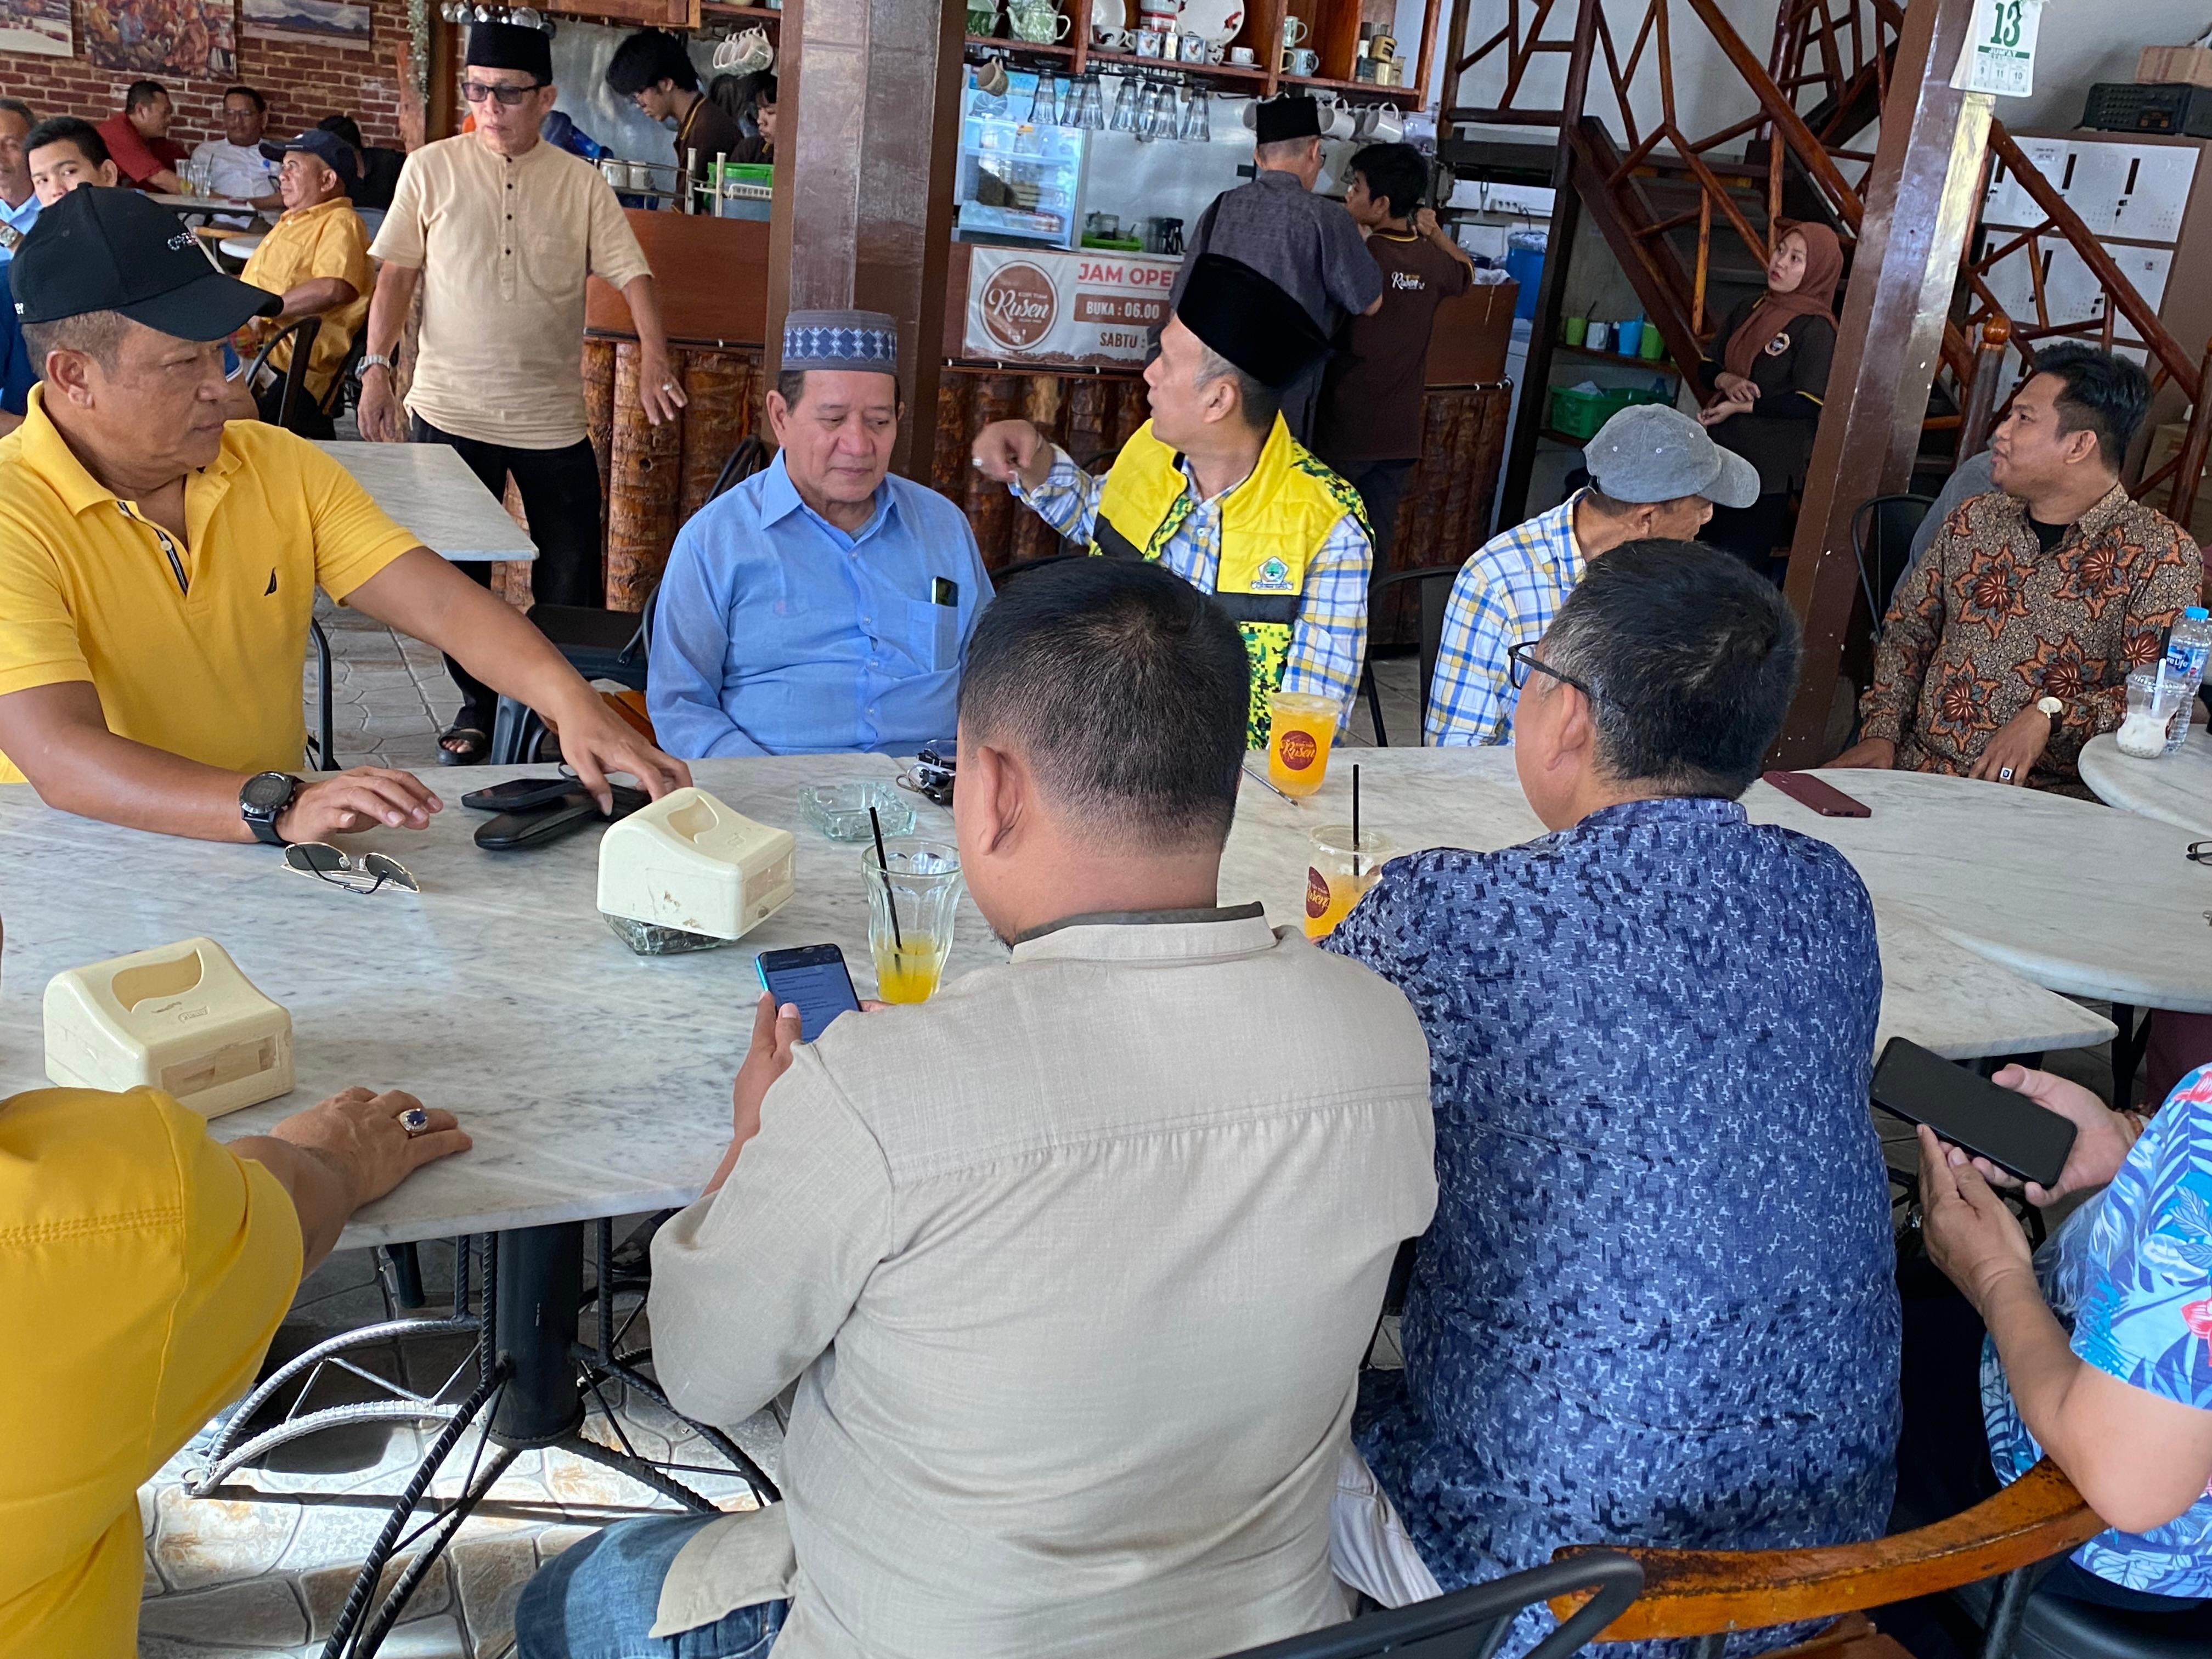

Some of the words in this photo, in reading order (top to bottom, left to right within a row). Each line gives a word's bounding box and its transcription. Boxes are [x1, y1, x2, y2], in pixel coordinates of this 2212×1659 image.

[1990, 0, 2023, 47] 13
[1078, 263, 1124, 283] JAM
[1129, 267, 1177, 286] OPE
[988, 289, 1049, 323] Rusen
[1086, 301, 1114, 316] BUKA
[1125, 302, 1160, 319] 06.00
[1100, 332, 1138, 348] SABTU
